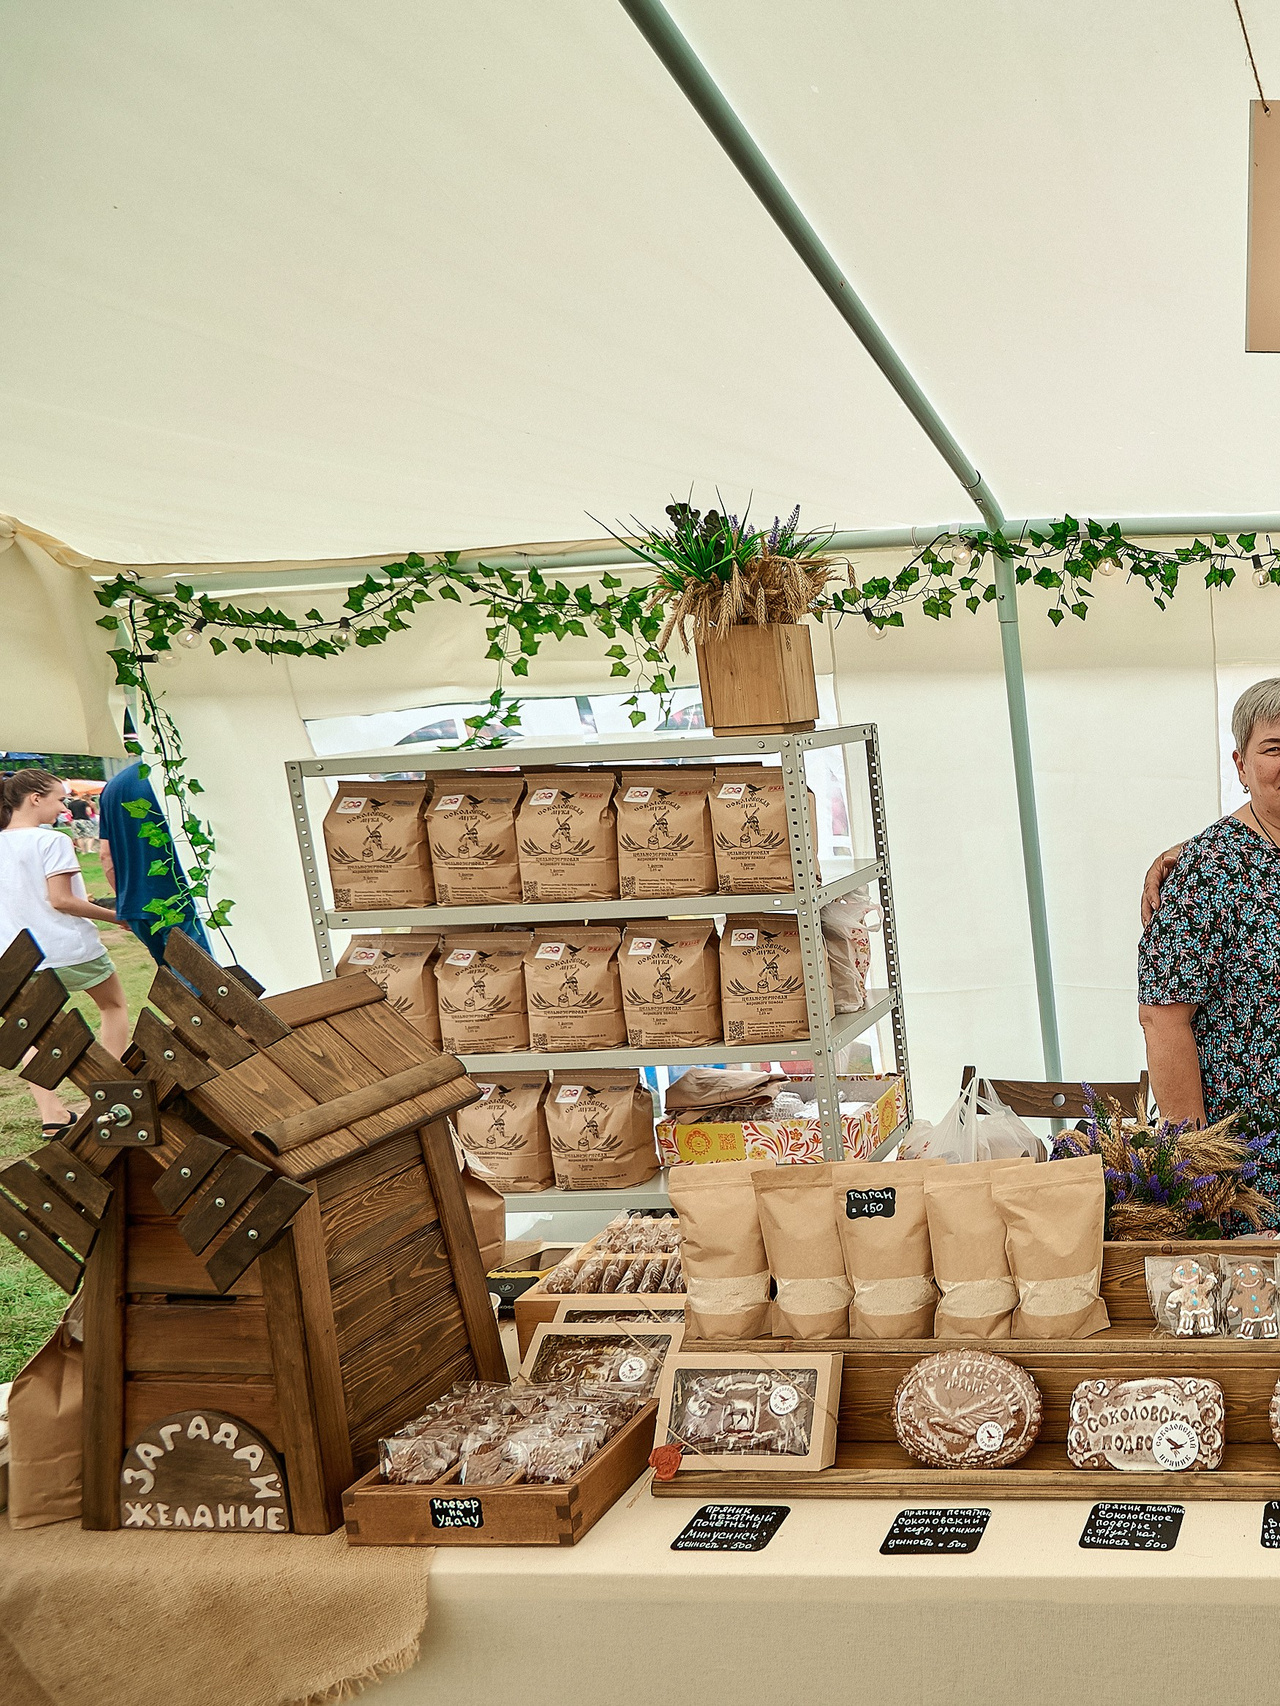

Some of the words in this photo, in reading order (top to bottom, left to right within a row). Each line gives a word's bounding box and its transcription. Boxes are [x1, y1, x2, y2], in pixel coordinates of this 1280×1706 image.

[862, 1203, 883, 1213] 150
[1102, 1435, 1153, 1454] ПОДВО
[123, 1416, 281, 1499] ЗАГАДАЙ
[433, 1499, 479, 1513] Клевер
[125, 1502, 285, 1531] ЖЕЛАНИЕ
[449, 1509, 463, 1517] на
[709, 1512, 776, 1522] печатный
[436, 1515, 479, 1527] Удачу
[693, 1519, 761, 1528] Почётный
[938, 1527, 983, 1535] орешком
[888, 1538, 933, 1548] ценность
[1084, 1536, 1130, 1546] ценность
[1145, 1540, 1167, 1548] 500
